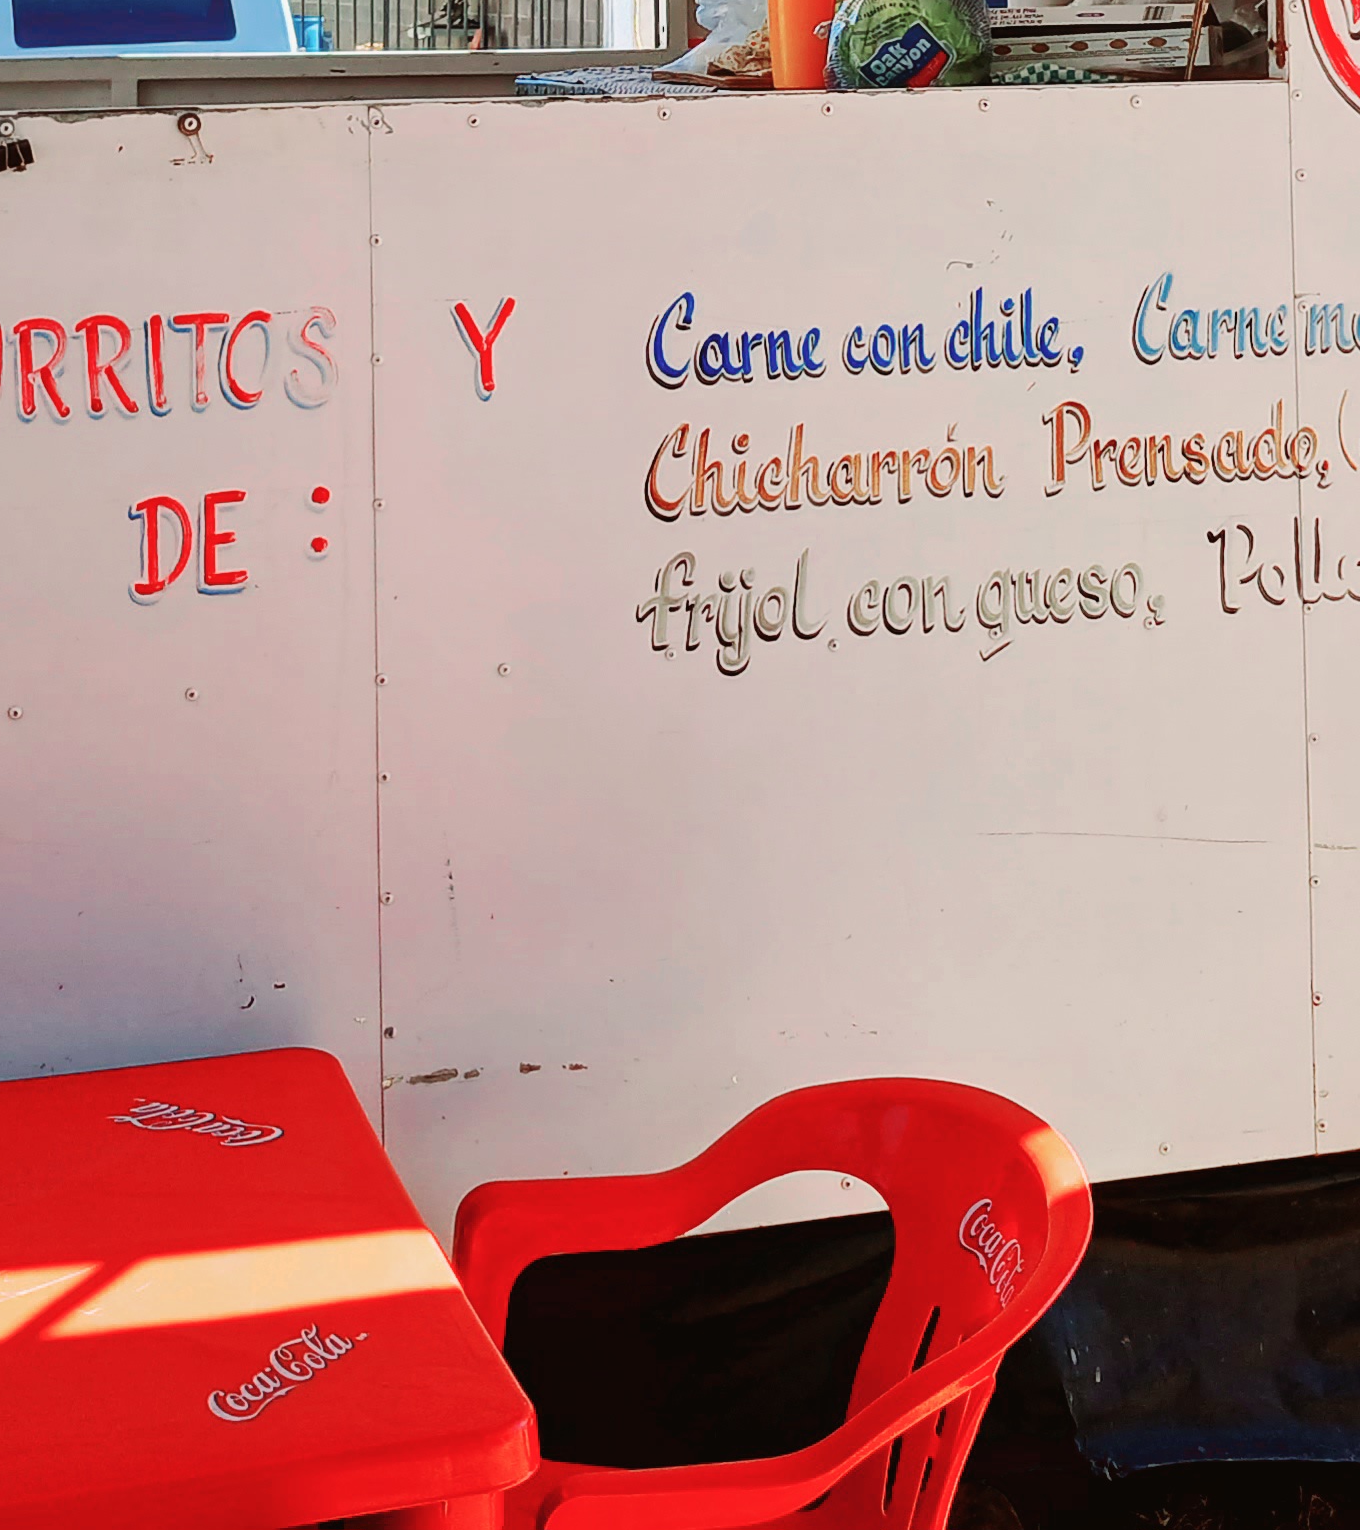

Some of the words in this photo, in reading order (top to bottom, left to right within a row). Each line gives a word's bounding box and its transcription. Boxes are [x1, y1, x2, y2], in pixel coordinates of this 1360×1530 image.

[869, 41, 908, 76] Oak
[875, 37, 932, 87] Canyon
[450, 295, 517, 400] Y
[646, 291, 827, 390] Carne
[841, 320, 937, 377] con
[945, 286, 1084, 374] chile,
[1131, 271, 1290, 364] Carne
[643, 422, 1005, 521] Chicharrón
[1042, 399, 1332, 498] Prensado,
[128, 488, 250, 602] DE
[846, 560, 968, 638] con
